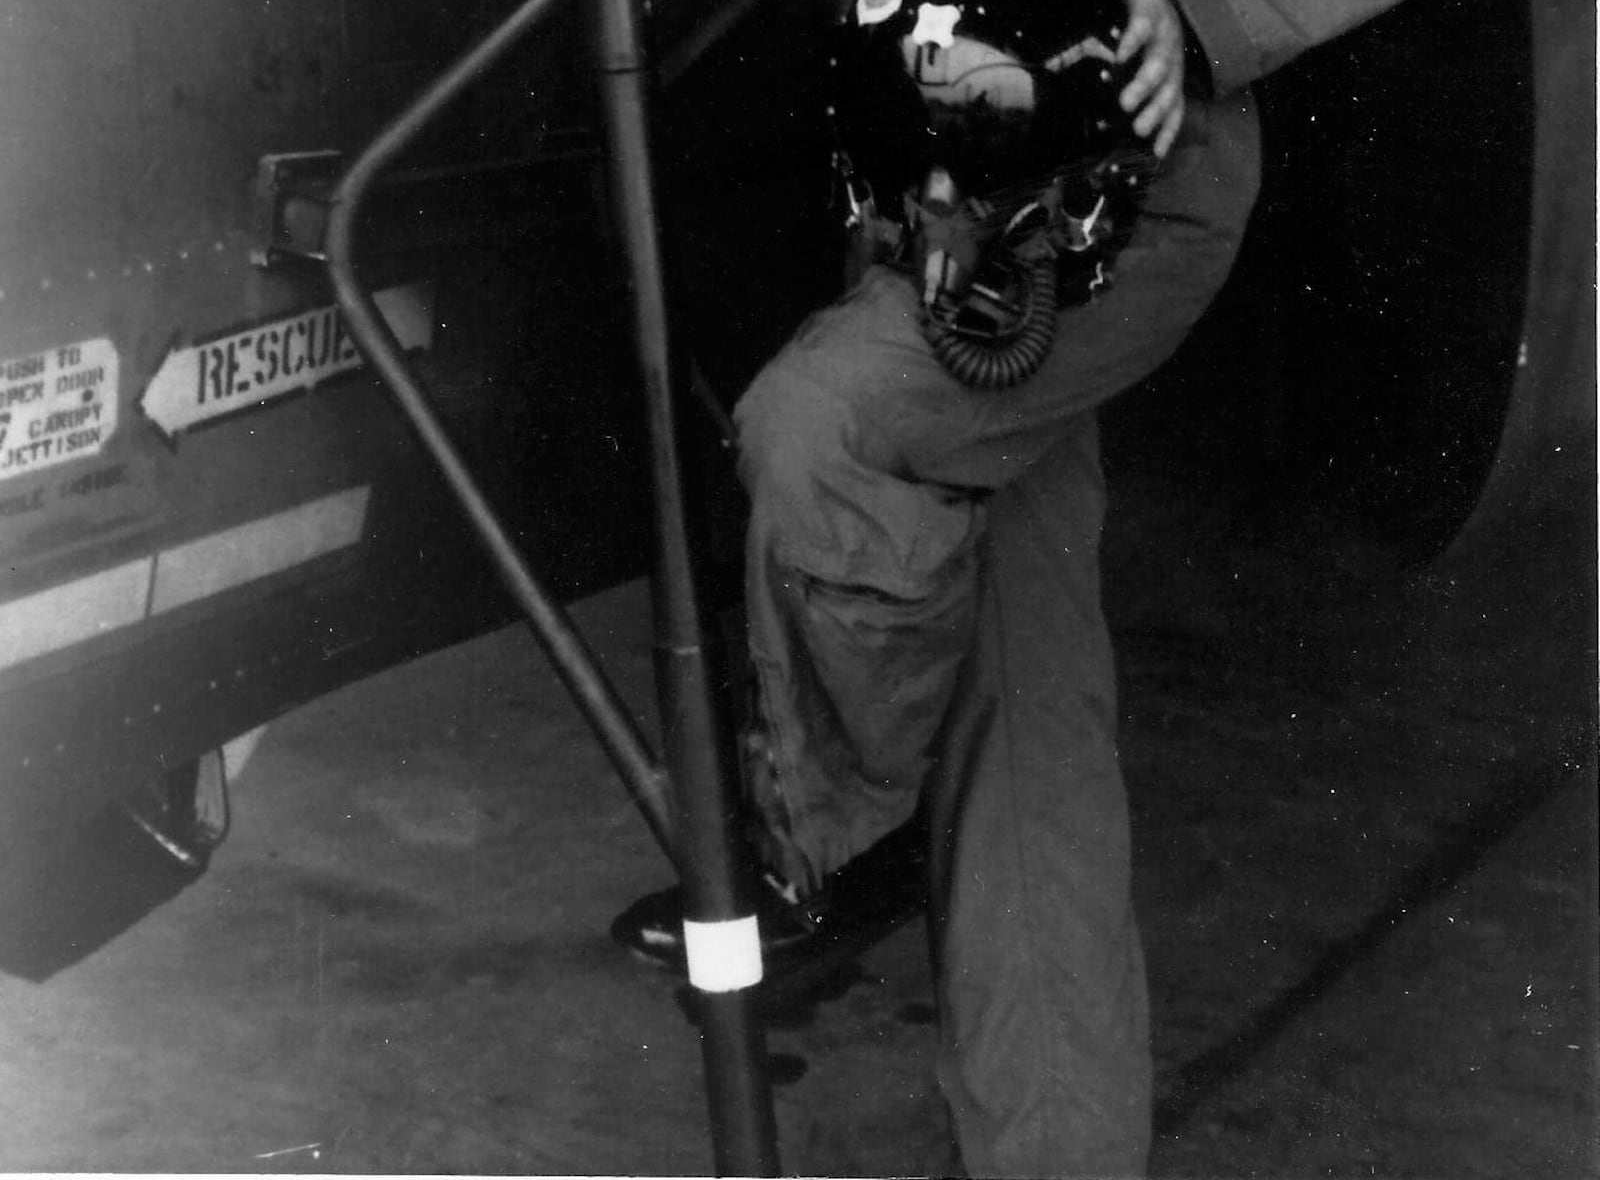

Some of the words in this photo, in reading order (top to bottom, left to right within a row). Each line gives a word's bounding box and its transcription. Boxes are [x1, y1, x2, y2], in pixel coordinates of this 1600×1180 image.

[58, 348, 81, 369] TO
[198, 308, 355, 404] RESCUE
[56, 366, 104, 395] DOOR
[29, 403, 102, 439] CANOPY
[2, 427, 100, 468] JETTISON
